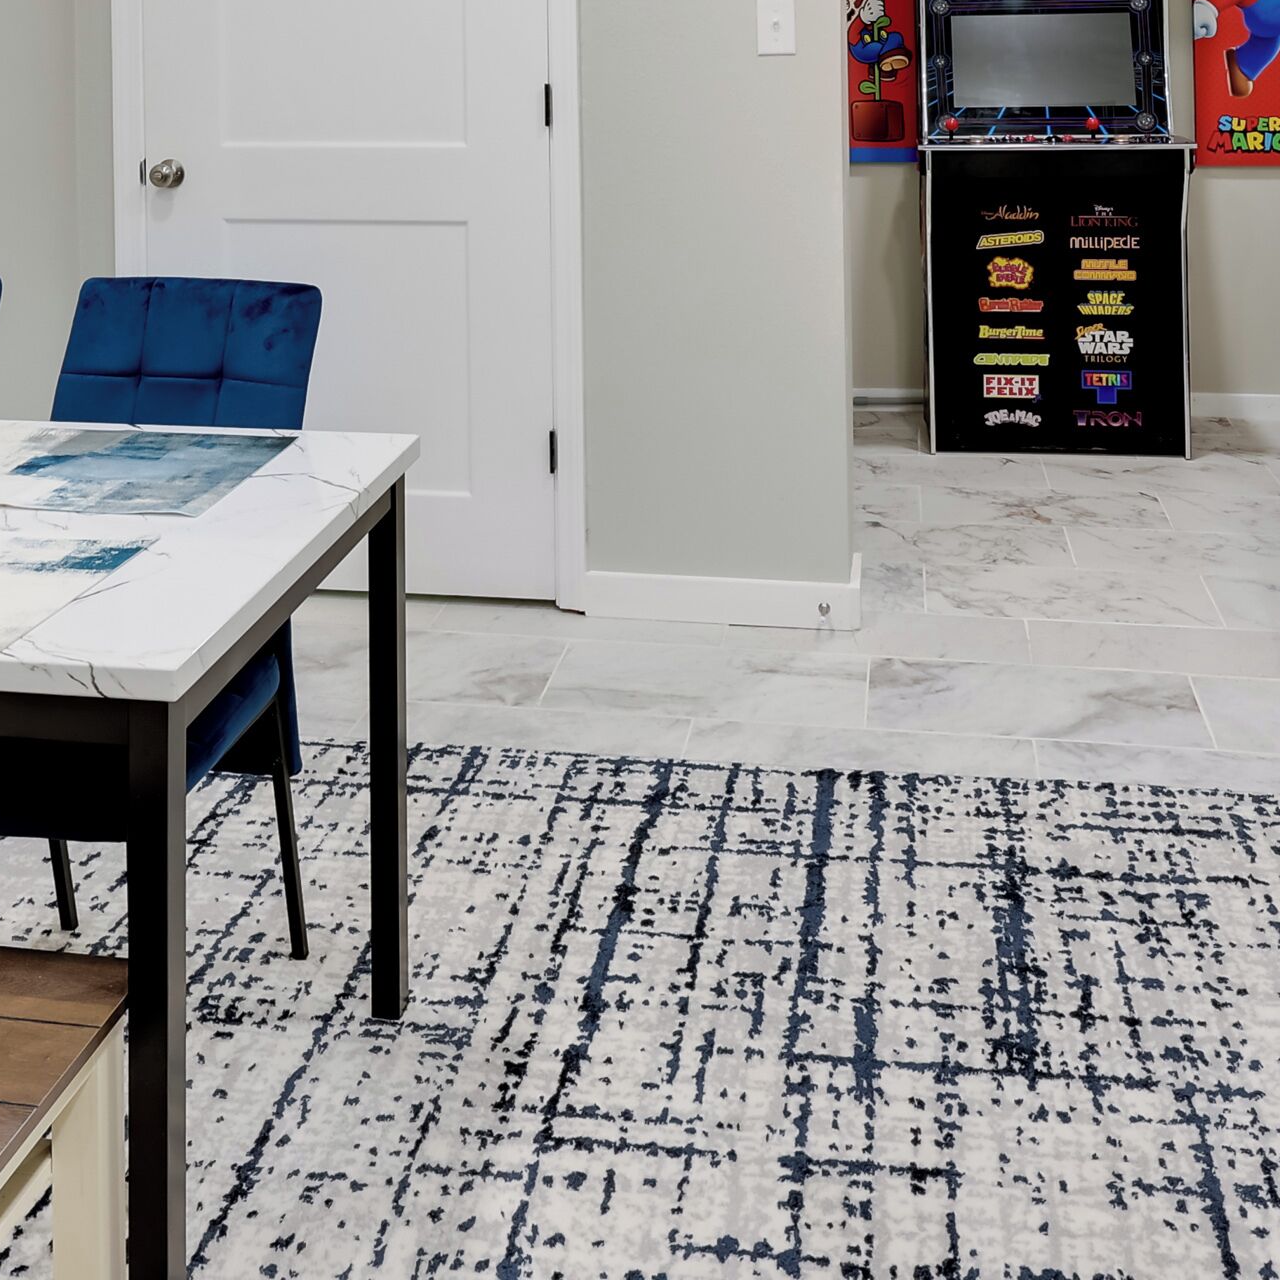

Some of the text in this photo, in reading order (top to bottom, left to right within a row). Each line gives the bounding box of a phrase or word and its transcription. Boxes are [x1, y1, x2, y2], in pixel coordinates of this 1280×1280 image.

[985, 205, 1040, 220] Aladdin
[1070, 215, 1139, 228] LION KING
[979, 232, 1042, 248] ASTEROIDS
[1087, 291, 1126, 304] SPACE
[1077, 304, 1135, 315] INVADERS
[978, 325, 1043, 339] BurgerTime
[1077, 330, 1134, 342] STAR
[1077, 342, 1134, 355] WARS
[1084, 355, 1128, 363] TRILOGY
[985, 376, 1036, 387] FIX-IT
[1084, 373, 1128, 387] TETRIS
[985, 386, 1036, 397] FELIX
[1073, 409, 1143, 427] TRON
